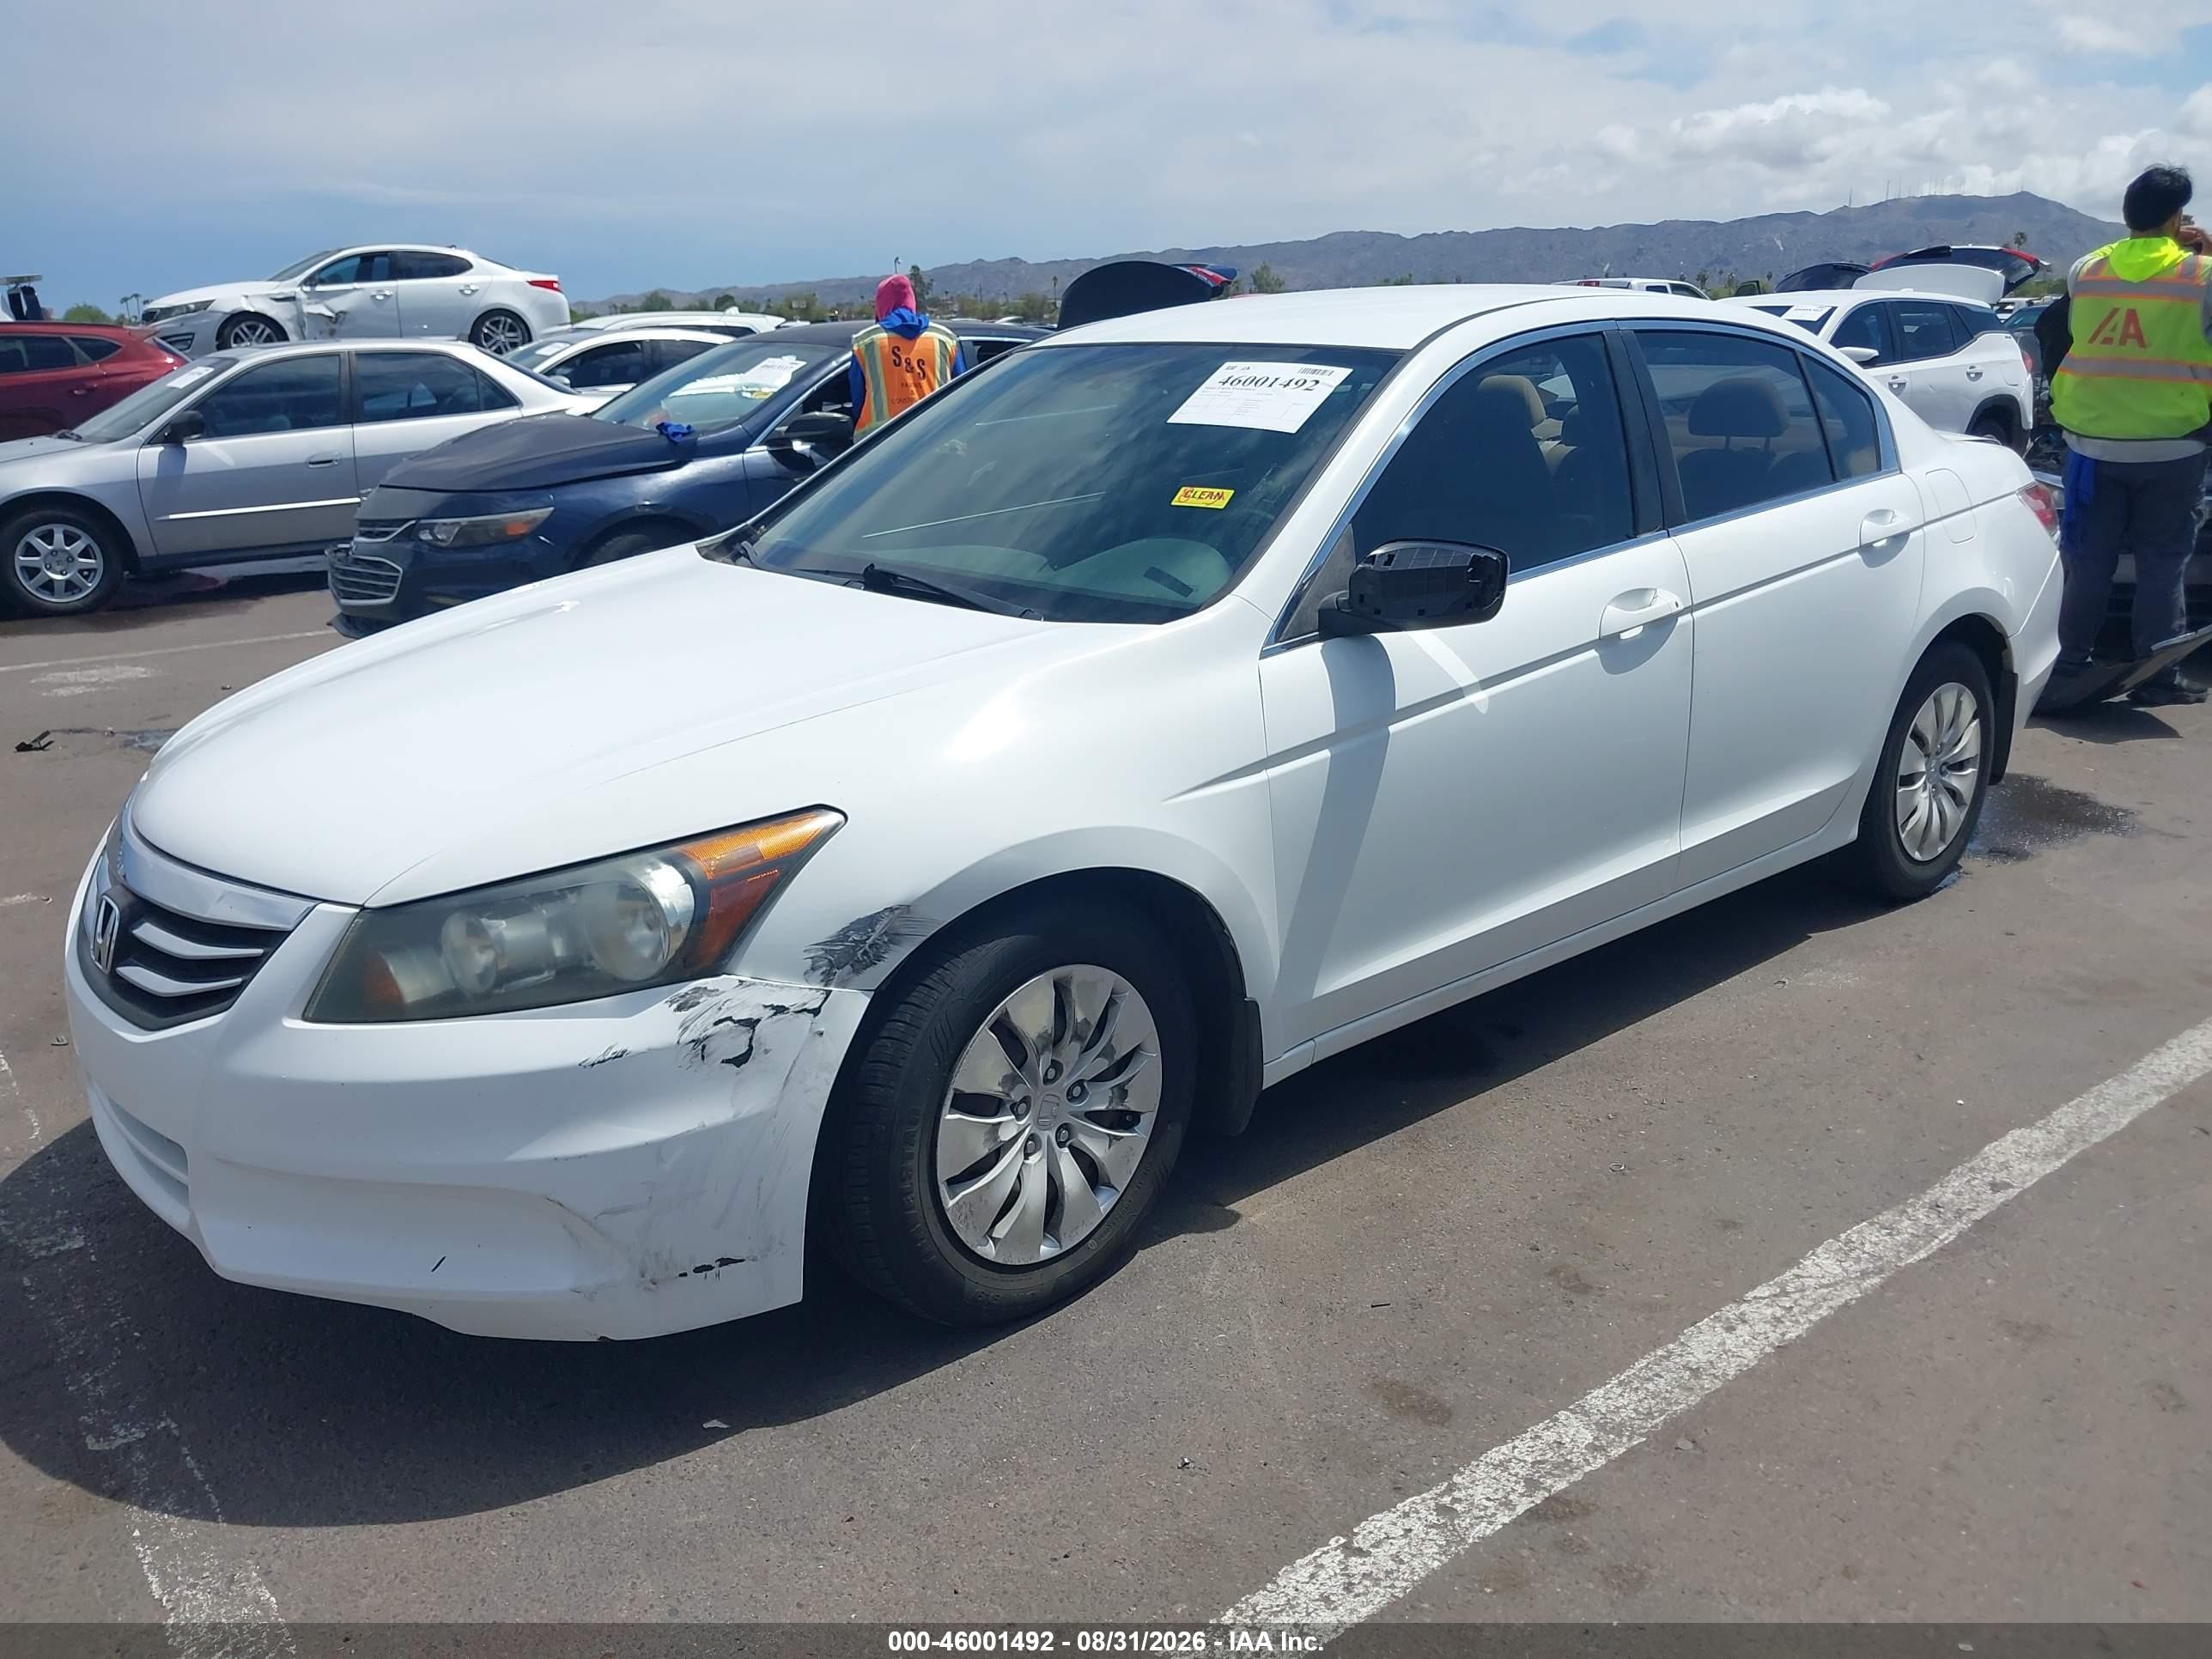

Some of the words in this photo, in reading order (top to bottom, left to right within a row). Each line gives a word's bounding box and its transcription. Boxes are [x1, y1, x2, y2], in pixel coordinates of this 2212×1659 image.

[892, 346, 902, 367] S
[905, 357, 914, 373] &
[917, 359, 926, 380] S
[1218, 374, 1320, 392] 46001492
